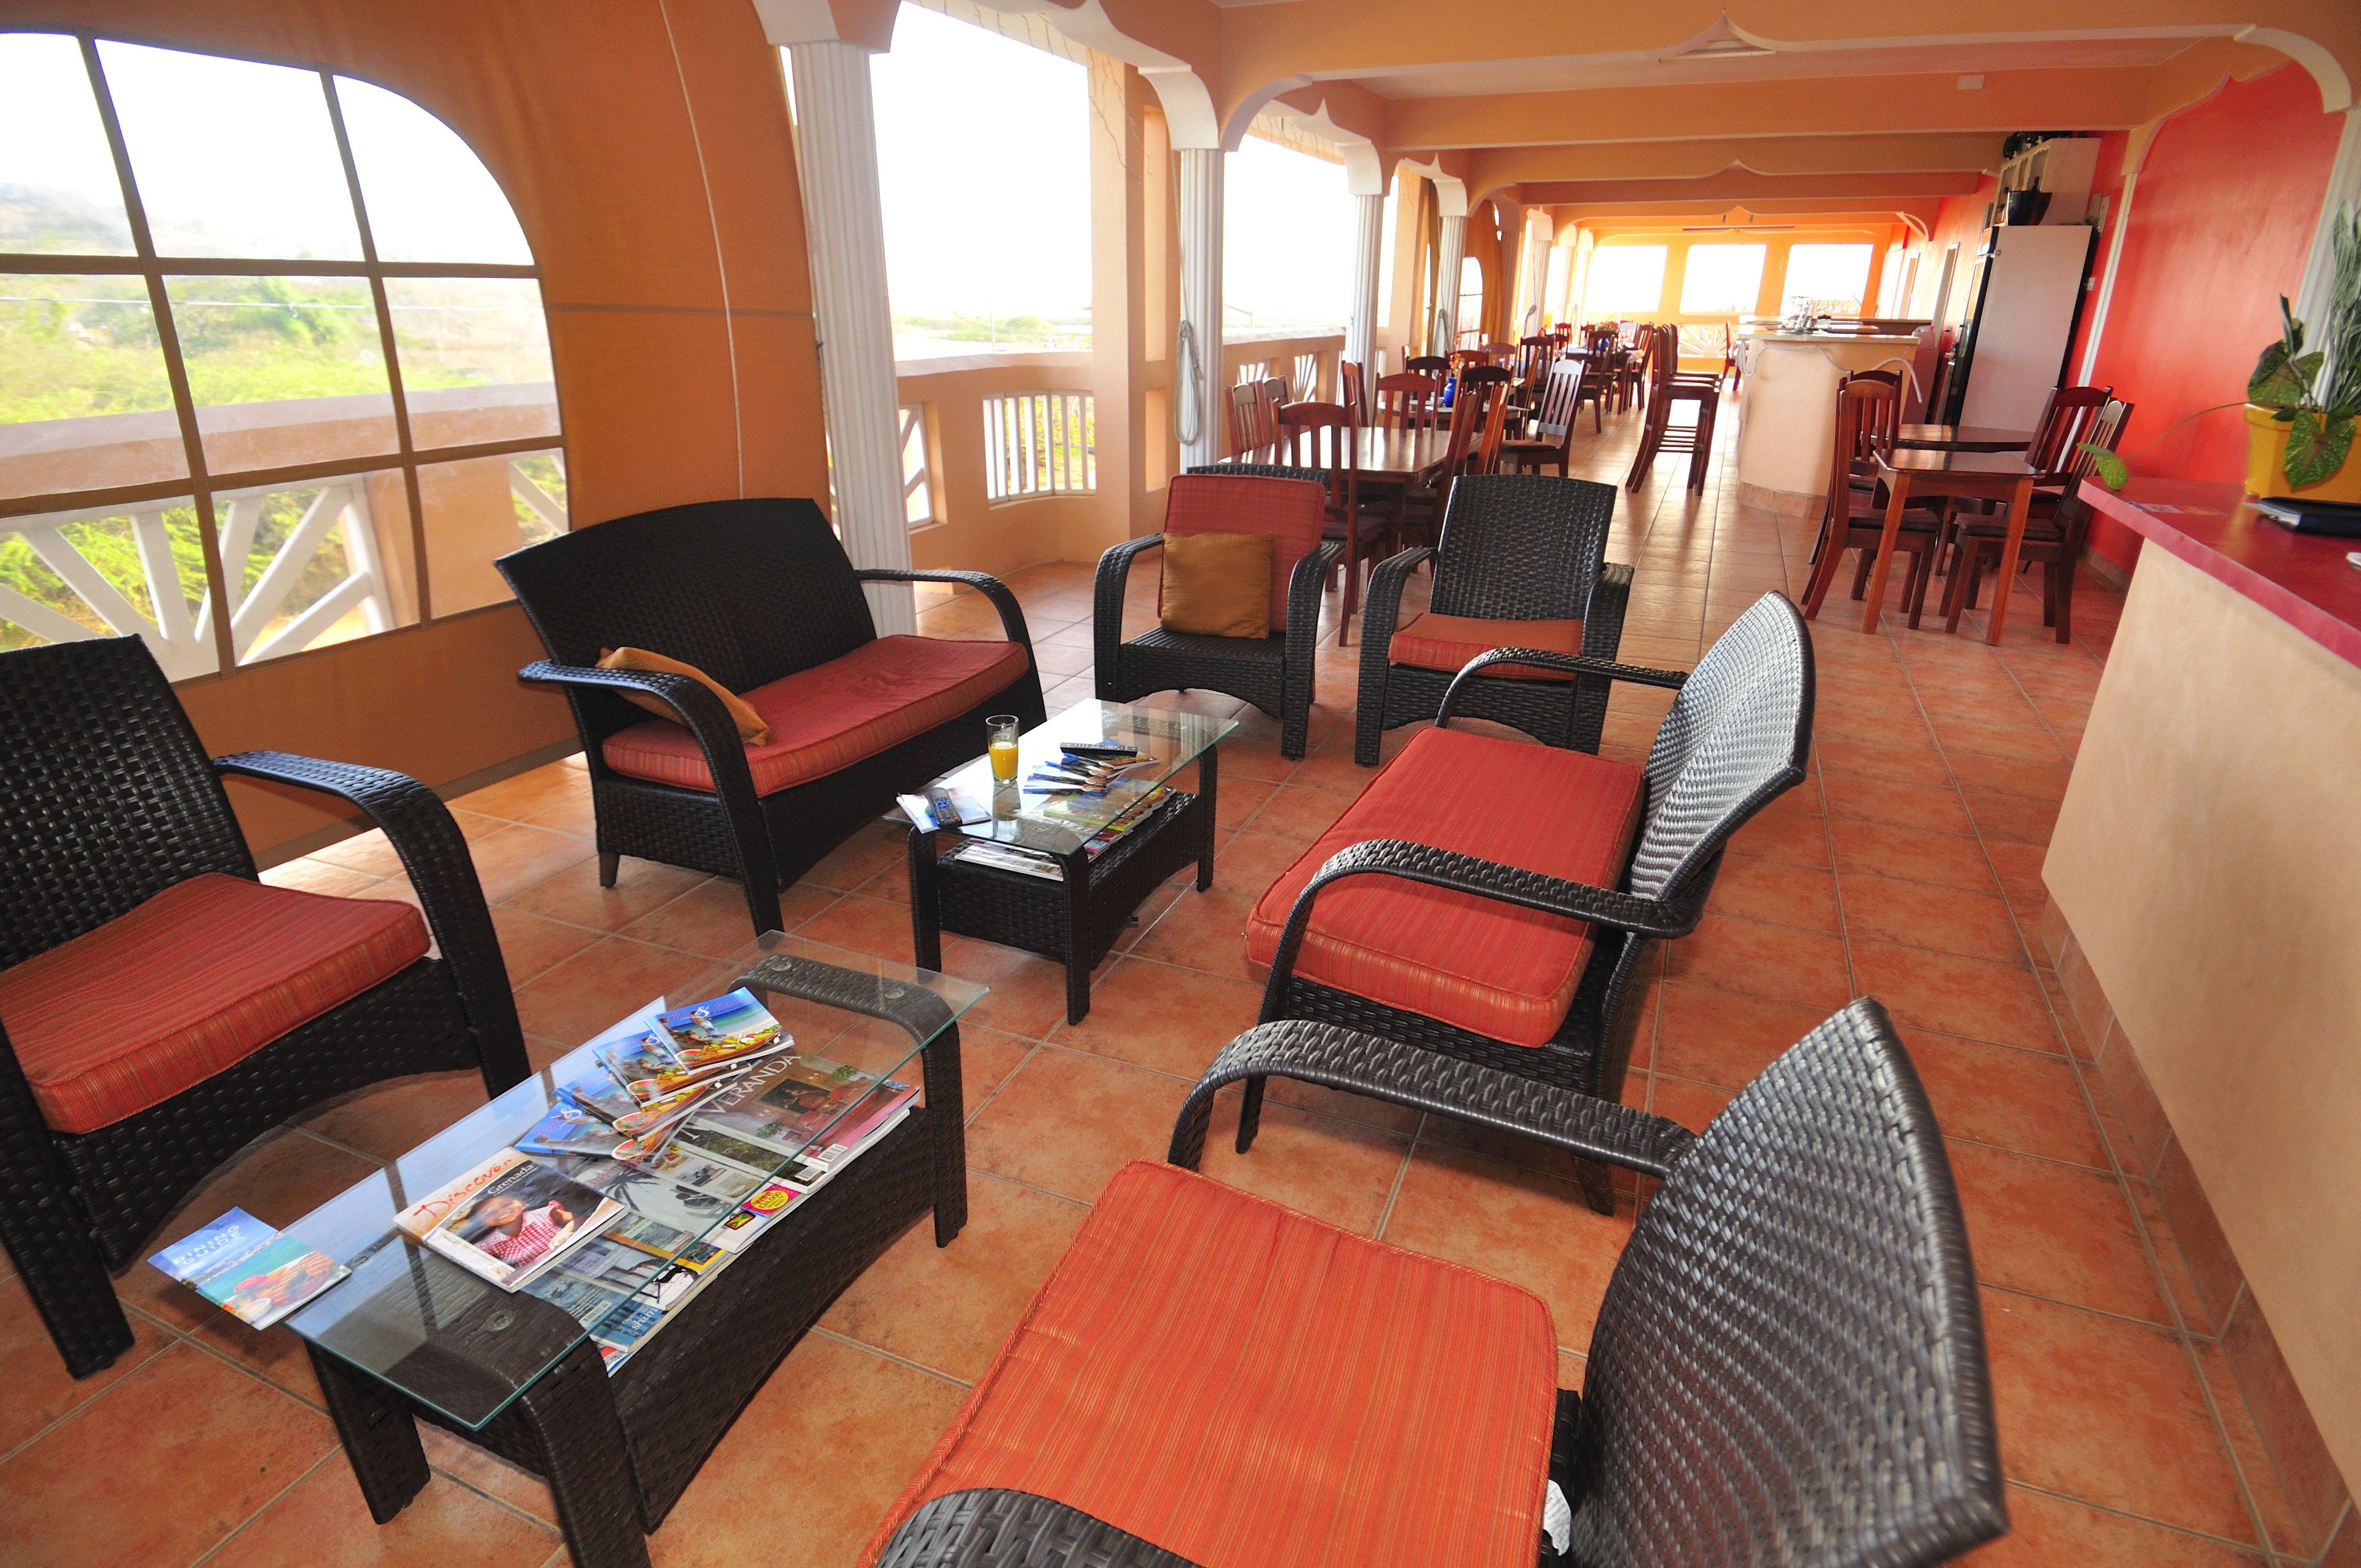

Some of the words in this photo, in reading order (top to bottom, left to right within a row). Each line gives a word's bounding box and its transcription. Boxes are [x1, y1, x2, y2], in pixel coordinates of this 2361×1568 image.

[697, 1055, 801, 1114] VERANDA
[413, 1158, 512, 1220] Discover
[487, 1164, 536, 1195] Grenada
[173, 1224, 239, 1264] DINING
[183, 1232, 242, 1265] GUIDE
